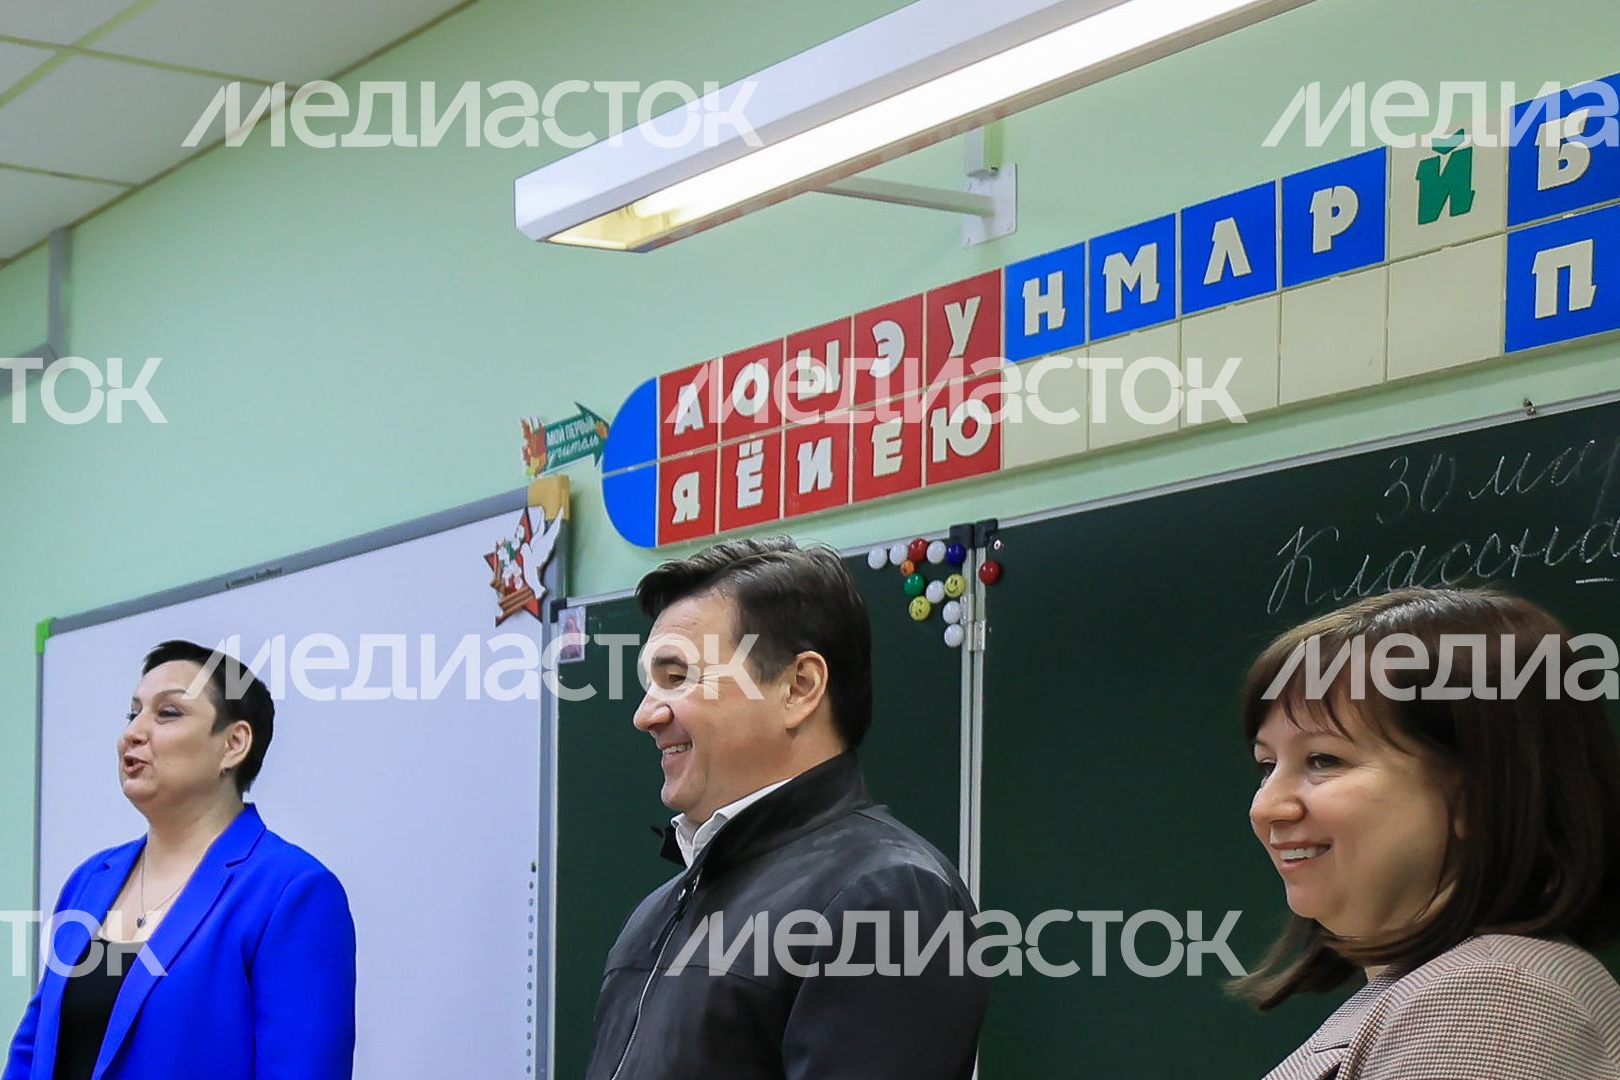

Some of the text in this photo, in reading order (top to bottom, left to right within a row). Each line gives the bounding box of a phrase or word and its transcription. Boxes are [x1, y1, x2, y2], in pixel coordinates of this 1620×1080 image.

[672, 239, 1596, 524] Я Ё И Е Ю П
[673, 108, 1592, 435] А О Ы Э У Н М Л Р Й Б
[1378, 454, 1456, 524] 30
